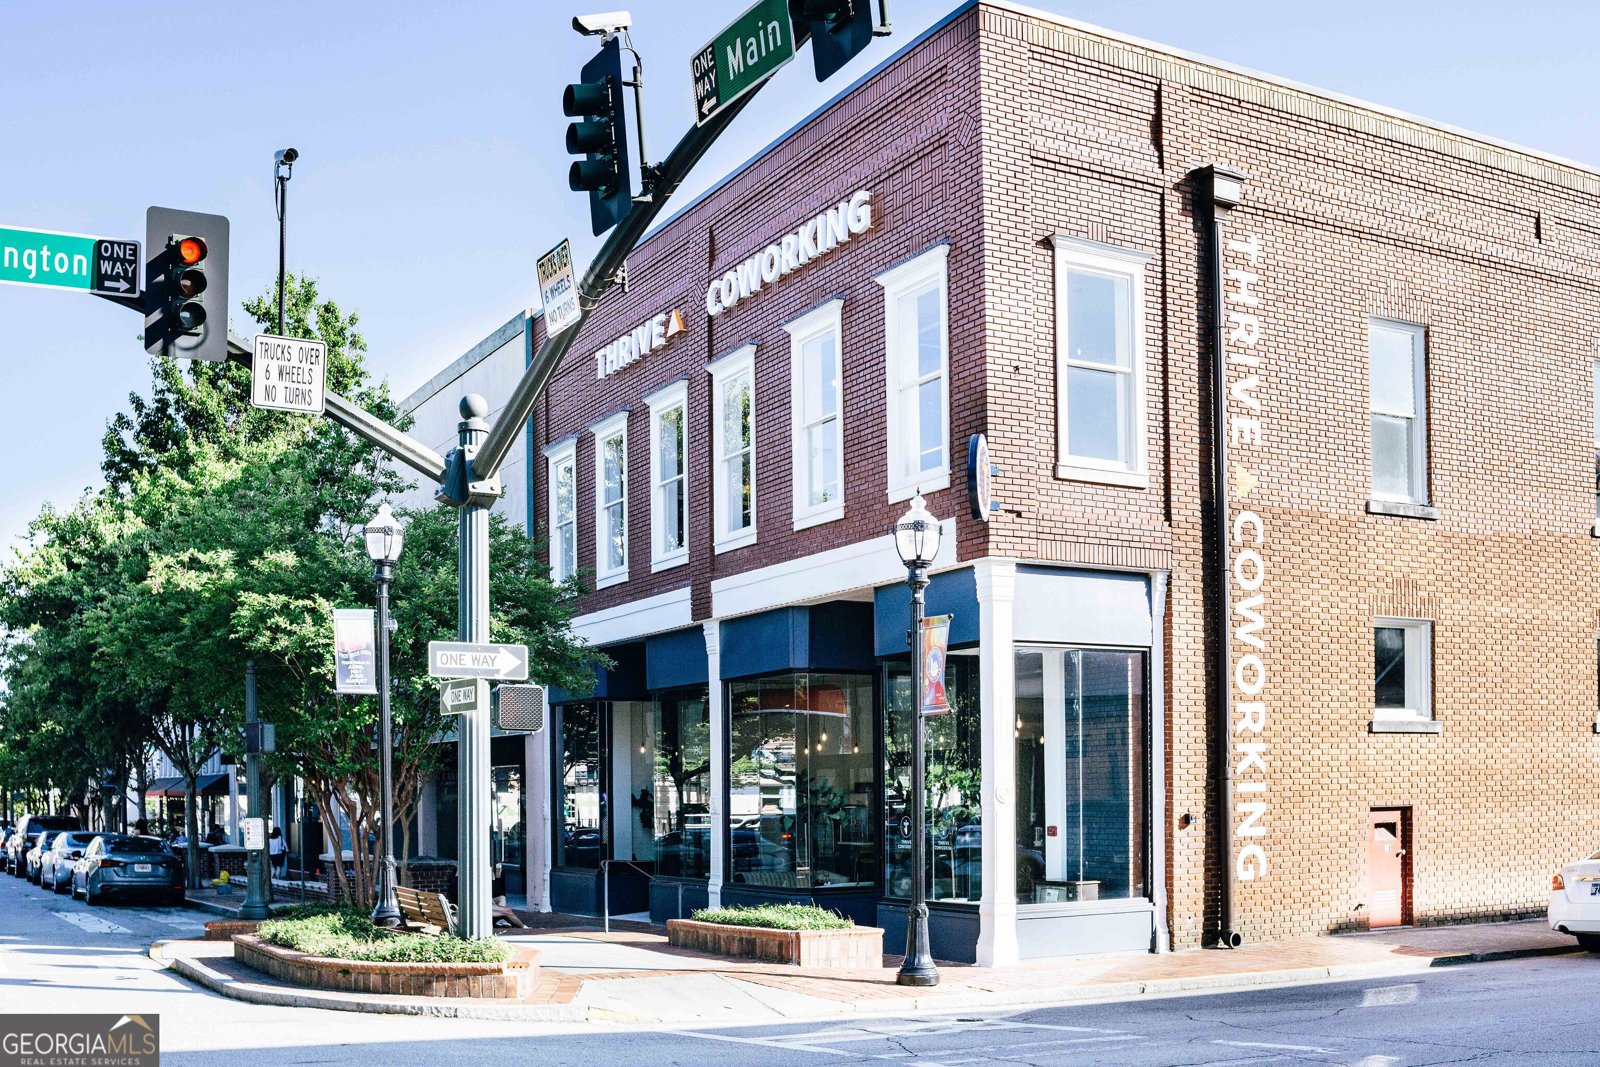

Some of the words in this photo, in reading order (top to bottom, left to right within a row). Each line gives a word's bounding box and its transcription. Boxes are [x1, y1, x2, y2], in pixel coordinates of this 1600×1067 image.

[693, 47, 715, 78] ONE
[726, 20, 782, 80] Main
[695, 68, 717, 100] WAY
[3, 245, 88, 279] ngton
[101, 243, 135, 260] ONE
[101, 260, 136, 277] WAY
[544, 290, 550, 304] 6
[550, 274, 572, 301] WHEELS
[595, 313, 669, 380] THRIVE
[706, 190, 874, 316] COWORKING
[548, 309, 558, 326] NO
[557, 297, 576, 320] TURNS
[260, 341, 292, 362] TRUCKS
[298, 346, 321, 366] OVER
[1228, 232, 1262, 447] THRIVE
[264, 363, 271, 381] 6
[277, 364, 313, 385] WHEELS
[264, 384, 277, 402] NO
[284, 386, 313, 406] TURNS
[440, 653, 467, 666] ONE
[471, 654, 498, 667] WAY
[451, 690, 462, 703] ONE
[462, 687, 474, 701] WAY
[1233, 509, 1268, 882] COWORKING
